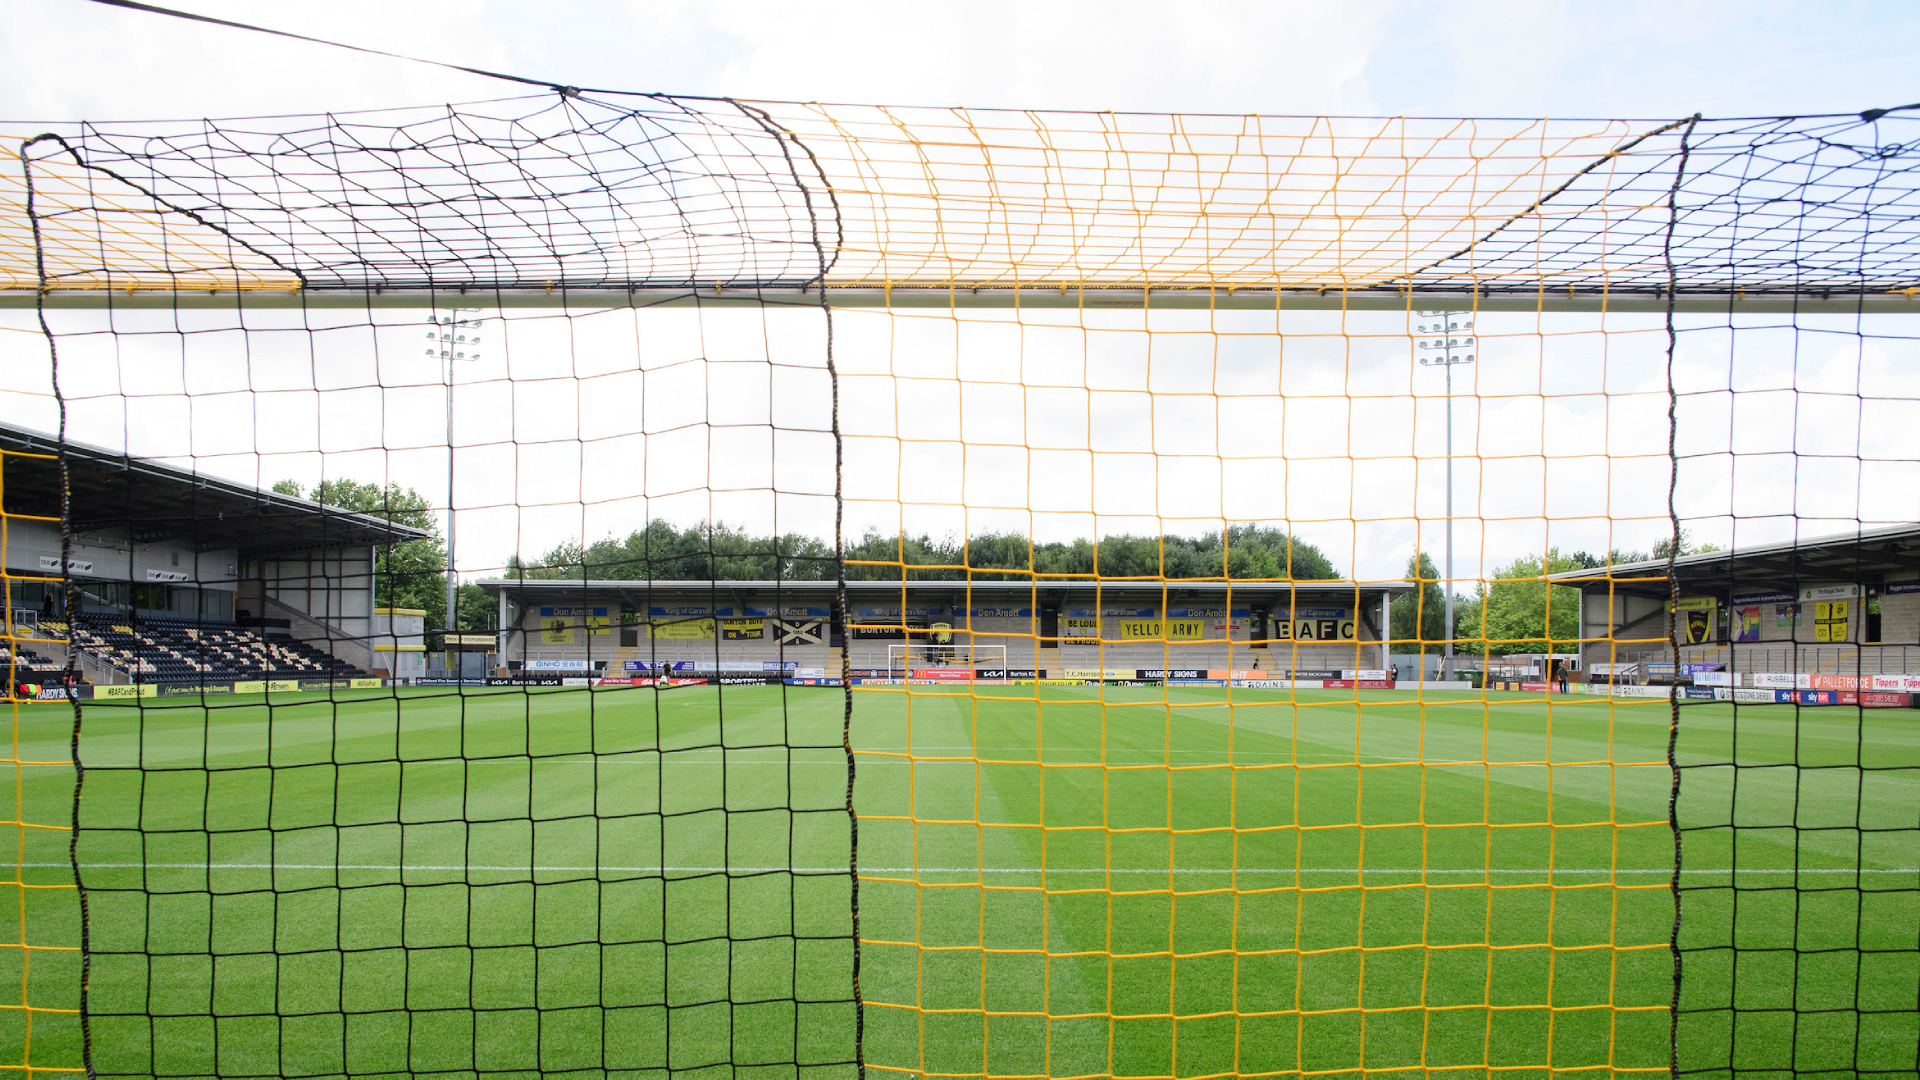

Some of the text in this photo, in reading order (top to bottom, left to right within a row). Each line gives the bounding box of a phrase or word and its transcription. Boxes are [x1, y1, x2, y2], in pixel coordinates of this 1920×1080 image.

[553, 608, 594, 616] Don Amtt
[785, 608, 808, 616] Amott
[978, 609, 1019, 617] Don Amott
[1083, 609, 1100, 617] "Kin
[1188, 609, 1229, 617] Don Amot
[1282, 609, 1299, 618] "Kg
[860, 624, 925, 634] BURTON OYS
[1126, 624, 1200, 636] YELLO ARMY
[728, 631, 737, 639] ON
[1766, 675, 1795, 683] RUSSELL
[1875, 678, 1899, 688] Tippers
[1903, 678, 1920, 688] Tippe
[36, 688, 59, 700] HARDY
[108, 688, 145, 696] #BAFCandPrud
[1726, 692, 1772, 700] STATSTONE DERBY
[1782, 692, 1800, 701] sky bt
[1808, 693, 1828, 702] sky bet
